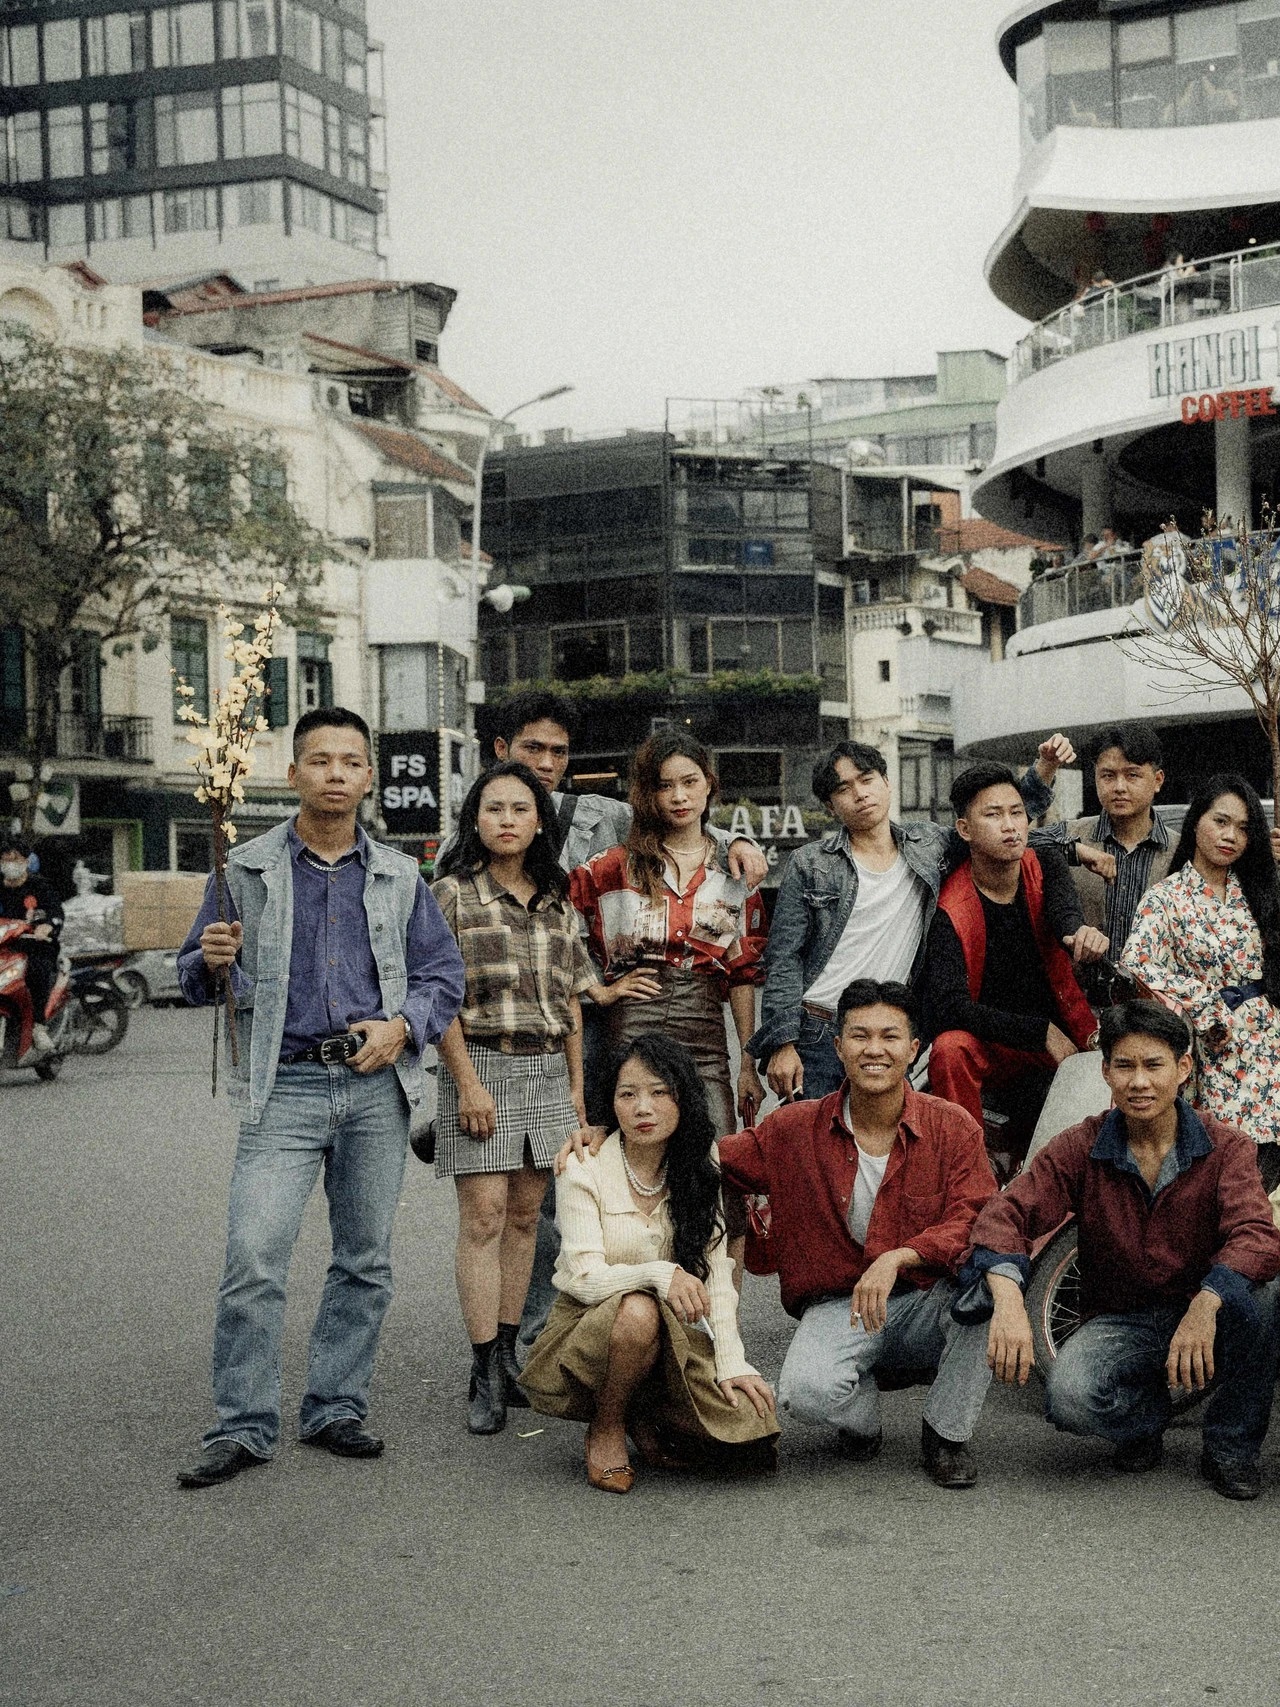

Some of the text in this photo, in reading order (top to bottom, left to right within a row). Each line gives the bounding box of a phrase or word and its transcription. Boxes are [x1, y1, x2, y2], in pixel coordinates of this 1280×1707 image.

[1147, 325, 1261, 398] HANOI
[1181, 386, 1277, 424] COFFEE
[390, 754, 427, 778] FS
[383, 785, 437, 809] SPA
[709, 805, 809, 839] AFA
